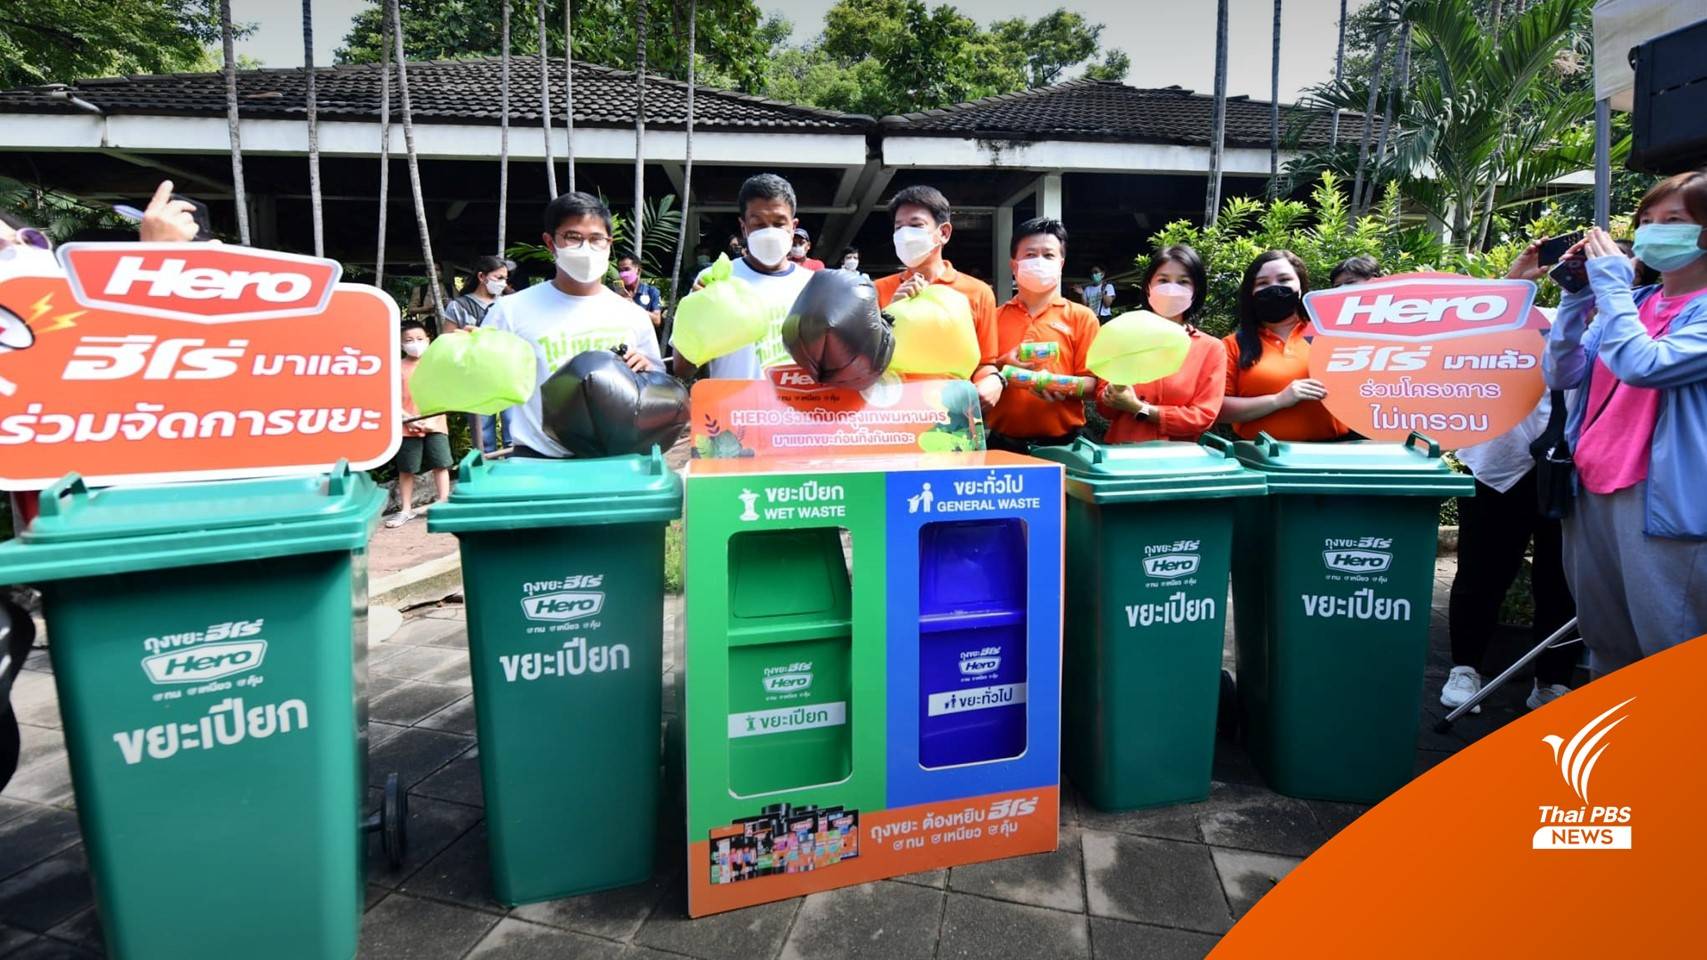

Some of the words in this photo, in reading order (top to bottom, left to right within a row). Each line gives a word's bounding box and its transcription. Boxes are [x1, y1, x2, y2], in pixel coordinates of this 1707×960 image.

[104, 256, 311, 302] Hero
[1336, 294, 1508, 325] Hero
[62, 335, 249, 380] ฮีโร่
[252, 347, 382, 376] มาแล้ว
[1326, 345, 1432, 371] ฮีโร่
[1443, 349, 1537, 370] มาแล้ว
[780, 372, 816, 385] He
[1360, 376, 1500, 398] ร่วมโครงการ
[0, 403, 382, 445] ร่วมจัดการขยะ
[733, 411, 780, 425] HERO
[783, 409, 834, 424] ร่วมกับ
[837, 411, 947, 429] กรุงเทพมหานคร
[1371, 404, 1488, 431] ไม่เทรวม
[765, 481, 844, 502] ขยะเปียก
[954, 470, 1023, 495] ขยะทั่วไป
[764, 508, 795, 520] WET
[797, 505, 846, 518] WASTE
[937, 500, 995, 513] GENERAL
[999, 497, 1040, 509] WASTE
[1152, 559, 1194, 572] Hero
[1333, 554, 1384, 567] Hero
[535, 599, 595, 614] Hero
[1126, 592, 1215, 627] ขยะเปียก
[1302, 588, 1411, 621] ขยะเปียก
[165, 650, 252, 675] Hero
[499, 637, 630, 682] ขยะเปียก
[966, 661, 997, 671] Hero
[771, 678, 807, 688] Hero
[959, 687, 1013, 707] ขยะทั่วไป
[113, 698, 308, 764] ขยะเปียก
[760, 708, 828, 729] ขยะเปียก
[871, 819, 918, 843] ถุงขยะ
[923, 808, 985, 830] ต้องหยิบ
[987, 796, 1039, 820] ฮีโร่
[906, 836, 925, 849] ทน
[943, 826, 982, 842] เหนียว
[1000, 819, 1018, 838] คุ้ม
